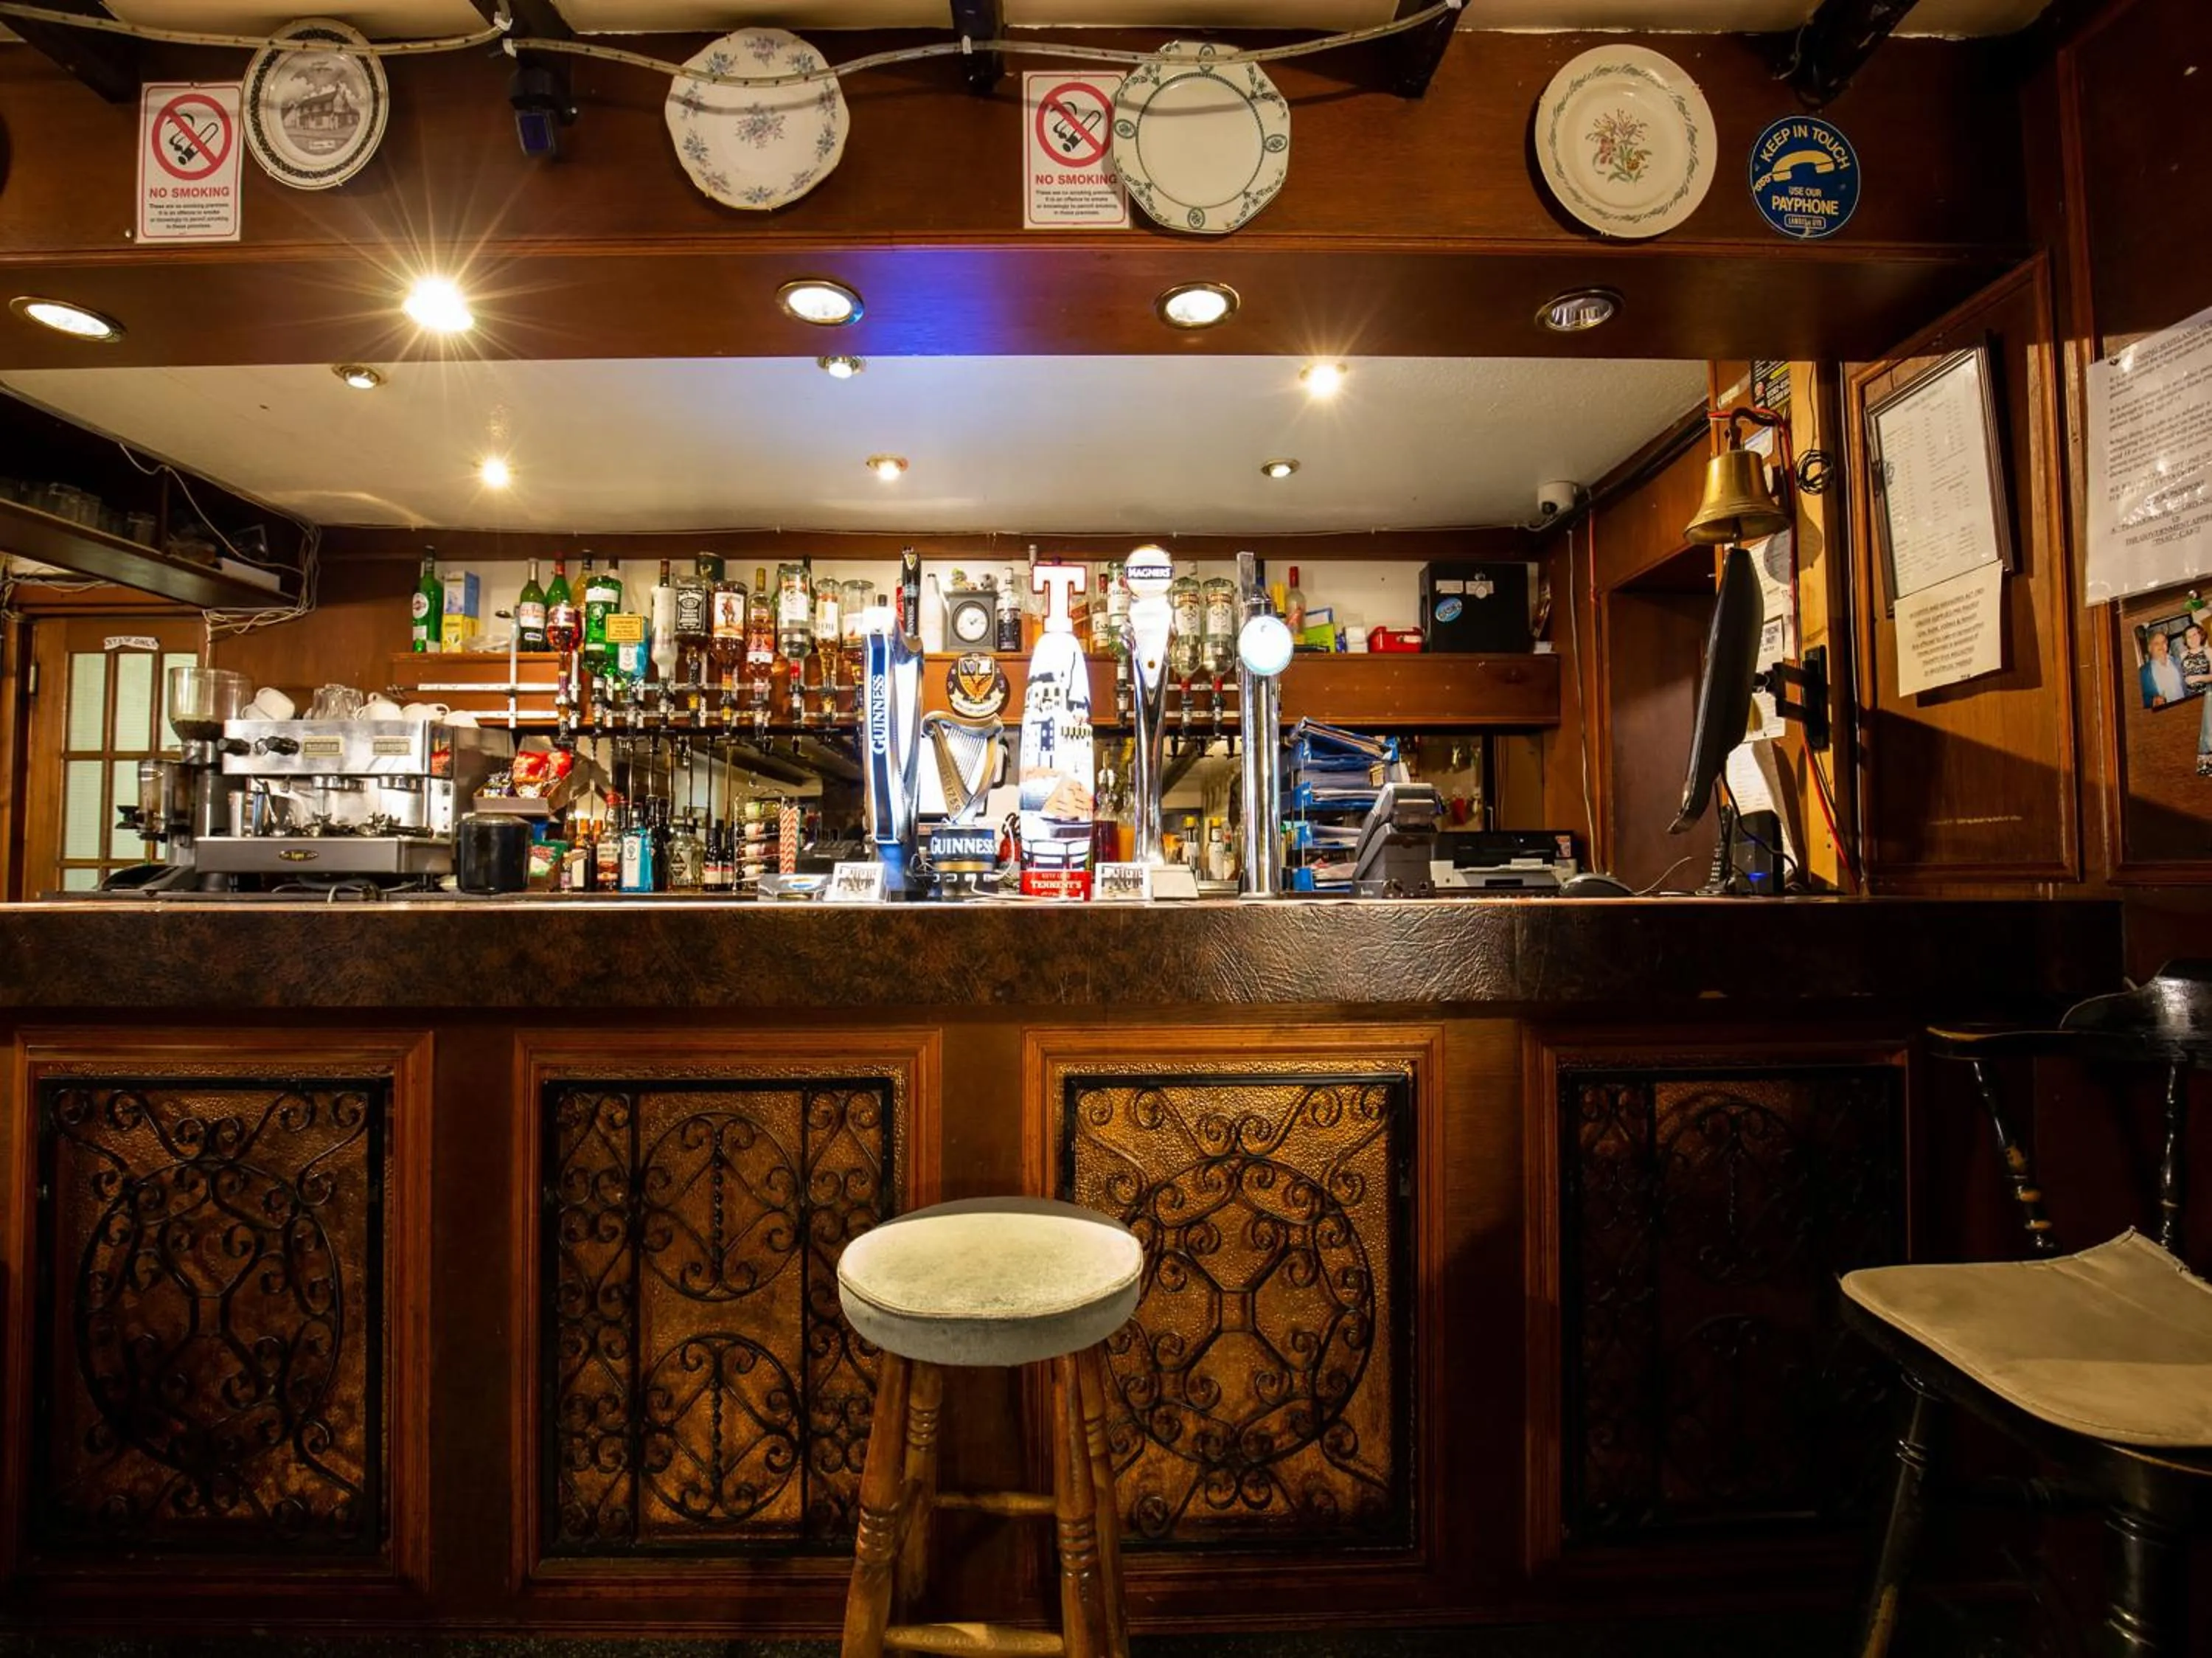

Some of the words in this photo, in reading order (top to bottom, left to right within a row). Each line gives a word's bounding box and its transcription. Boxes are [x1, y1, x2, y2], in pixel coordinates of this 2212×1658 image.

[1760, 128, 1790, 162] KEEP
[1793, 125, 1808, 139] IN
[1812, 127, 1851, 170] TOUCH
[1035, 174, 1054, 185] NO
[1057, 173, 1118, 185] SMOKING
[150, 187, 167, 198] NO
[172, 186, 230, 198] SMOKING
[1788, 186, 1804, 195] USE
[1805, 187, 1822, 197] OUR
[1771, 195, 1839, 215] PAYPHONE
[1127, 566, 1172, 578] MAGNERS
[872, 673, 886, 755] GUINNESS
[931, 836, 995, 855] GUINNESS
